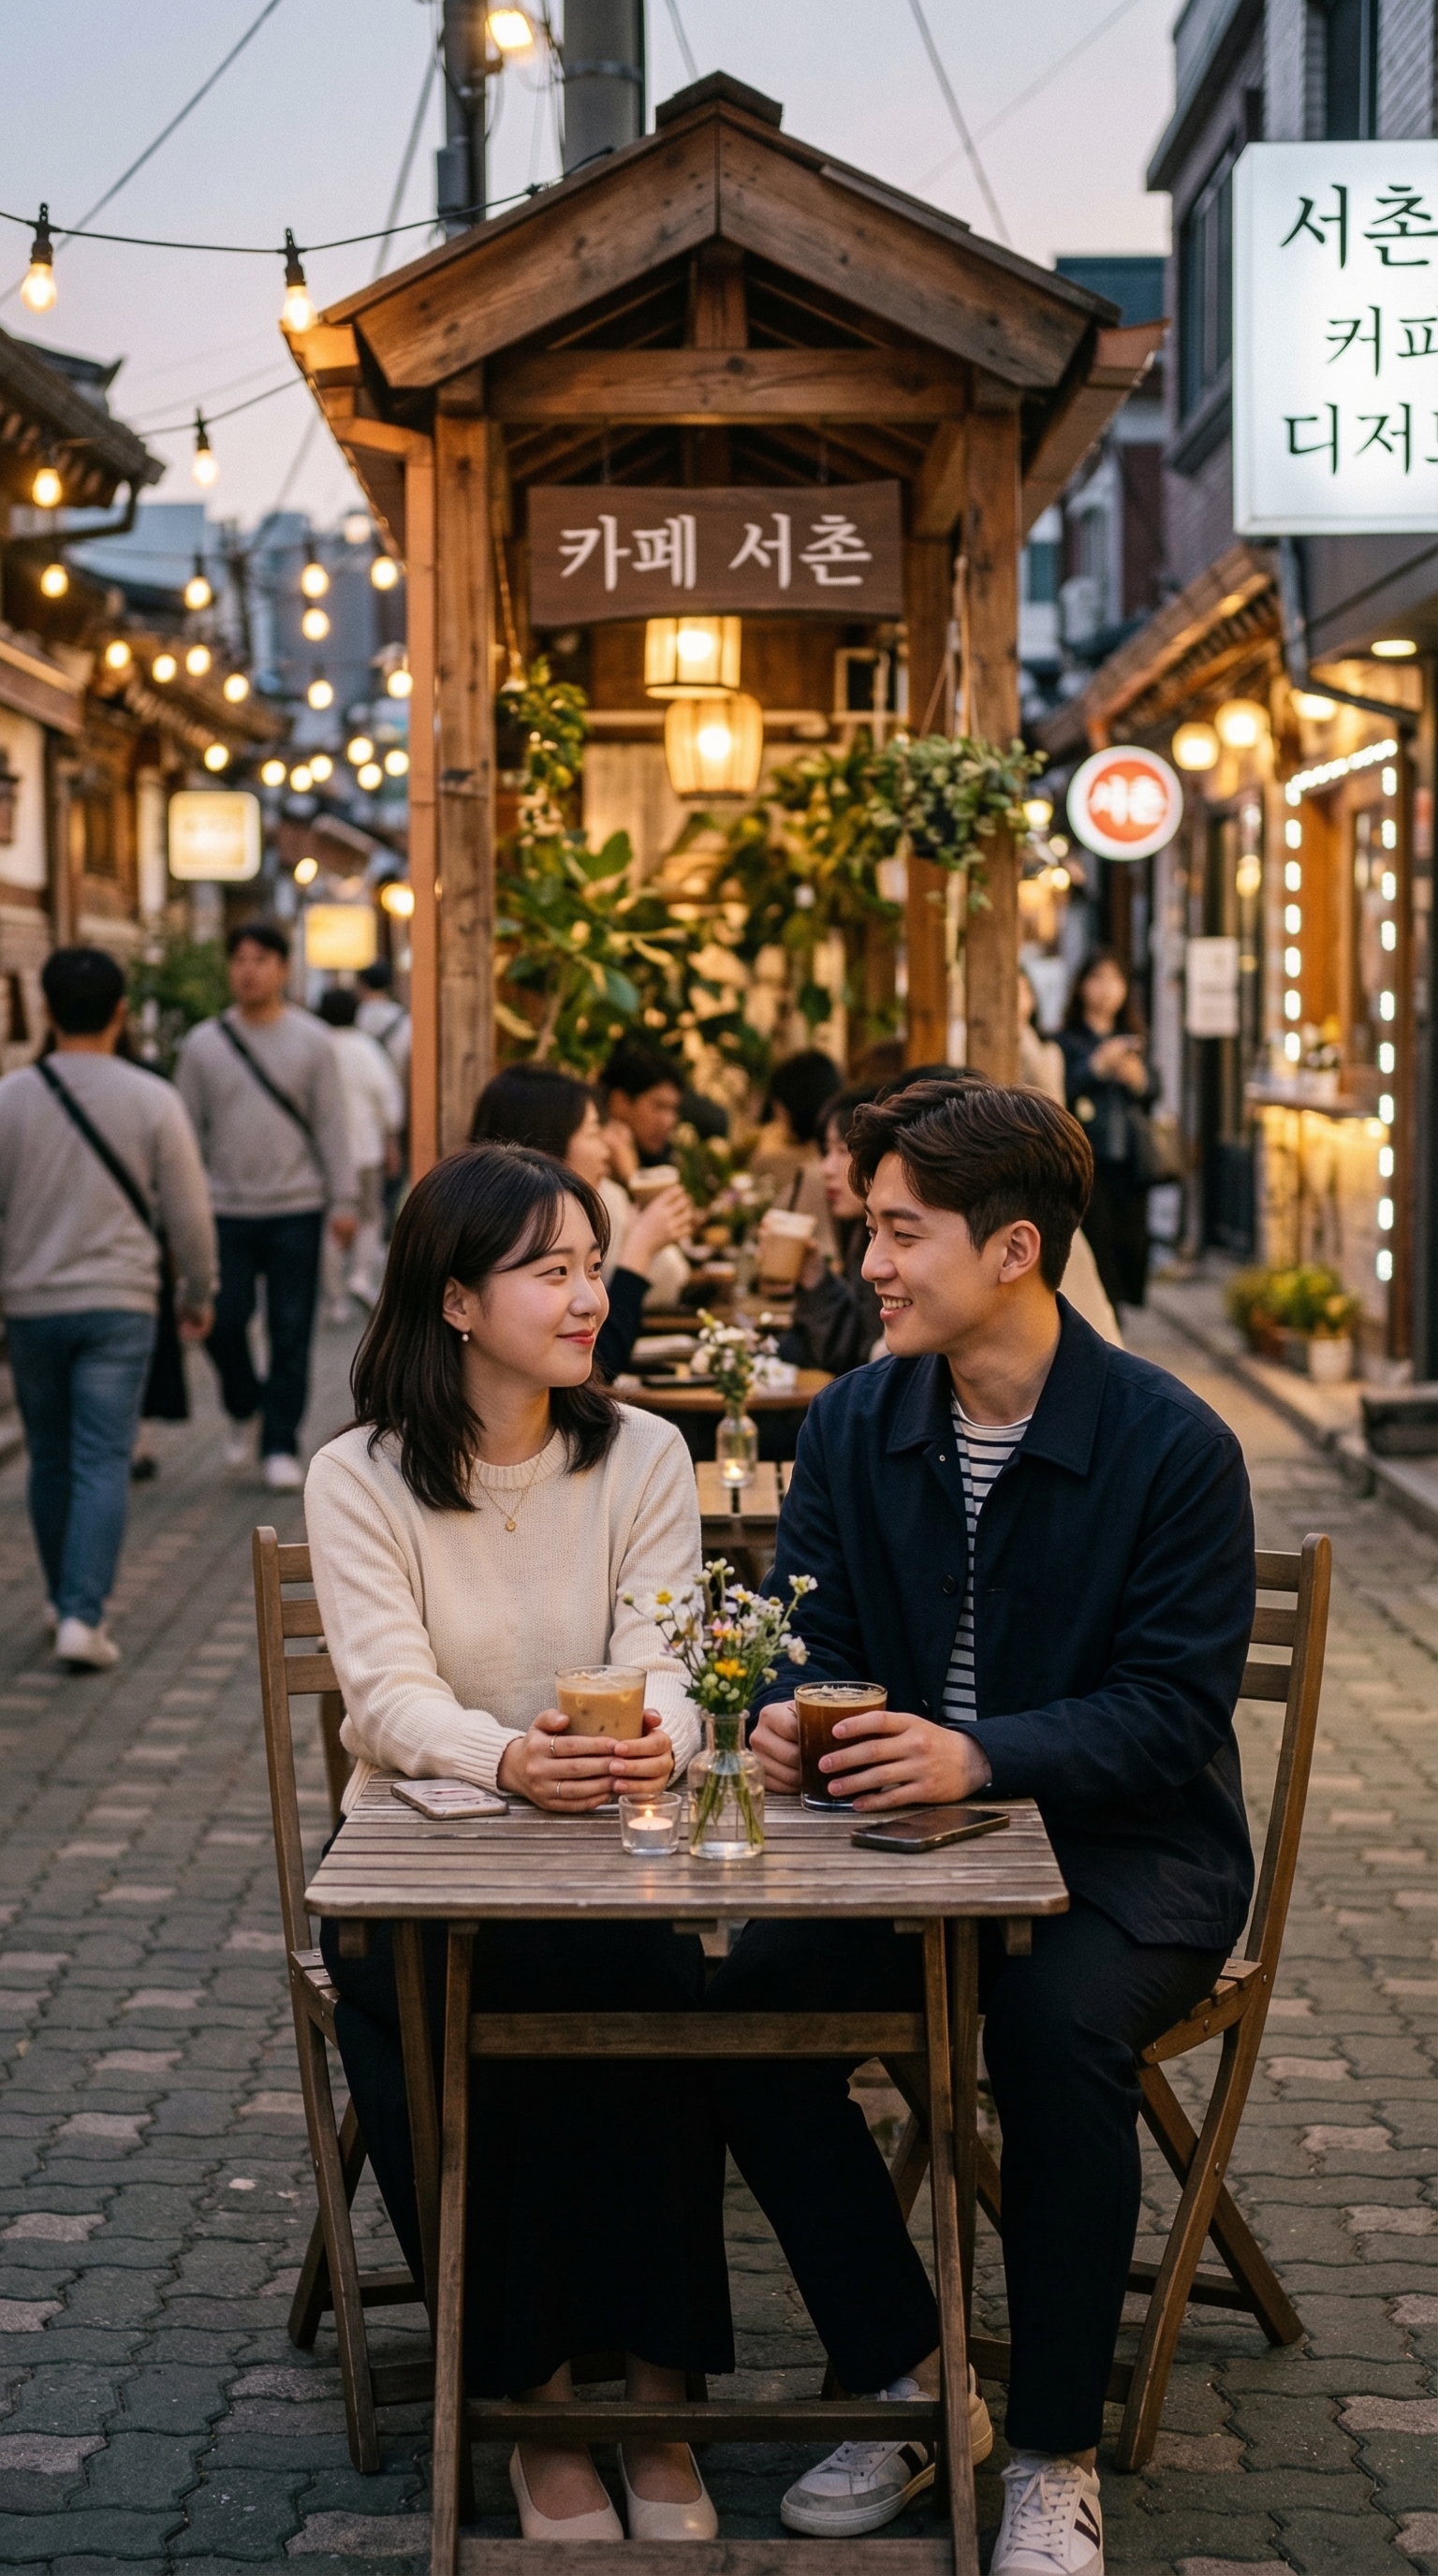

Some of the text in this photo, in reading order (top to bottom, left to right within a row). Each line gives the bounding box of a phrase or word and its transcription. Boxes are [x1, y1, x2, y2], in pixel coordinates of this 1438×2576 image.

[1281, 183, 1438, 270] 서촌
[1283, 402, 1438, 475] 디저
[559, 513, 873, 592] 카페 서촌
